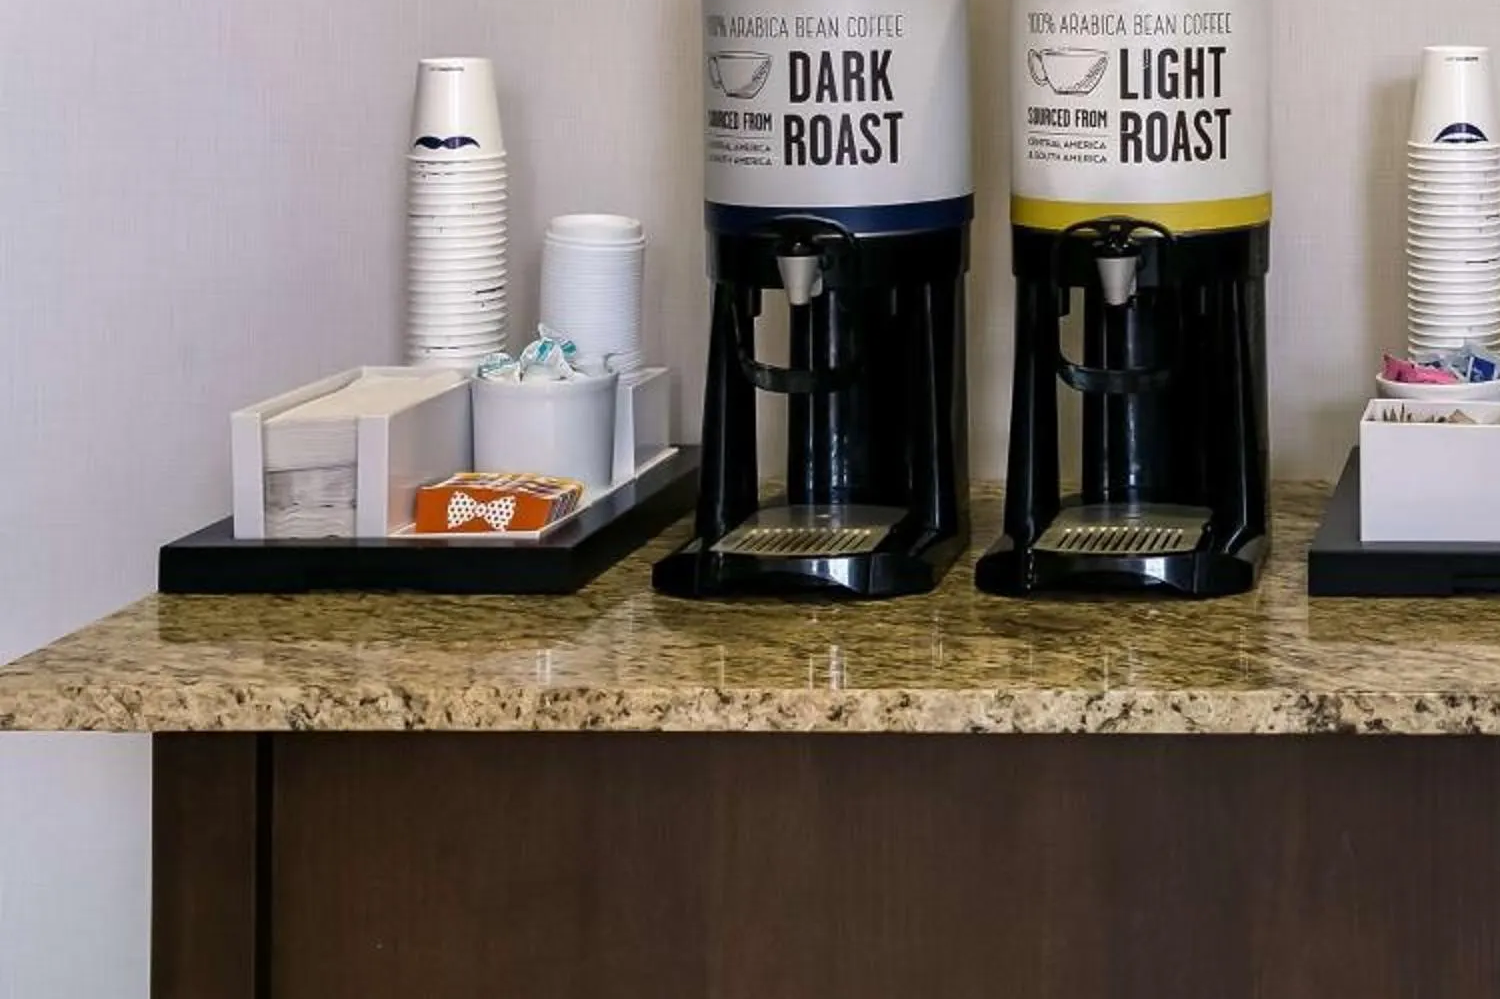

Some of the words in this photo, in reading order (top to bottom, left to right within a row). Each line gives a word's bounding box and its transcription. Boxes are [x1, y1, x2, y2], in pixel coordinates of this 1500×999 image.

[729, 16, 789, 38] ARABICA
[795, 16, 839, 38] BEAN
[847, 14, 905, 38] COFFEE
[1060, 13, 1127, 36] ARABICA
[1133, 14, 1177, 36] BEAN
[1183, 12, 1232, 35] COFFEE
[788, 49, 895, 104] DARK
[1119, 47, 1227, 100] LIGHT
[743, 112, 773, 131] FROM
[1027, 106, 1071, 127] SOURCED
[1075, 108, 1108, 128] FROM
[783, 111, 904, 167] ROAST
[1063, 140, 1107, 150] AMERICA
[1119, 108, 1232, 164] ROAST
[1063, 154, 1107, 163] AMERICA
